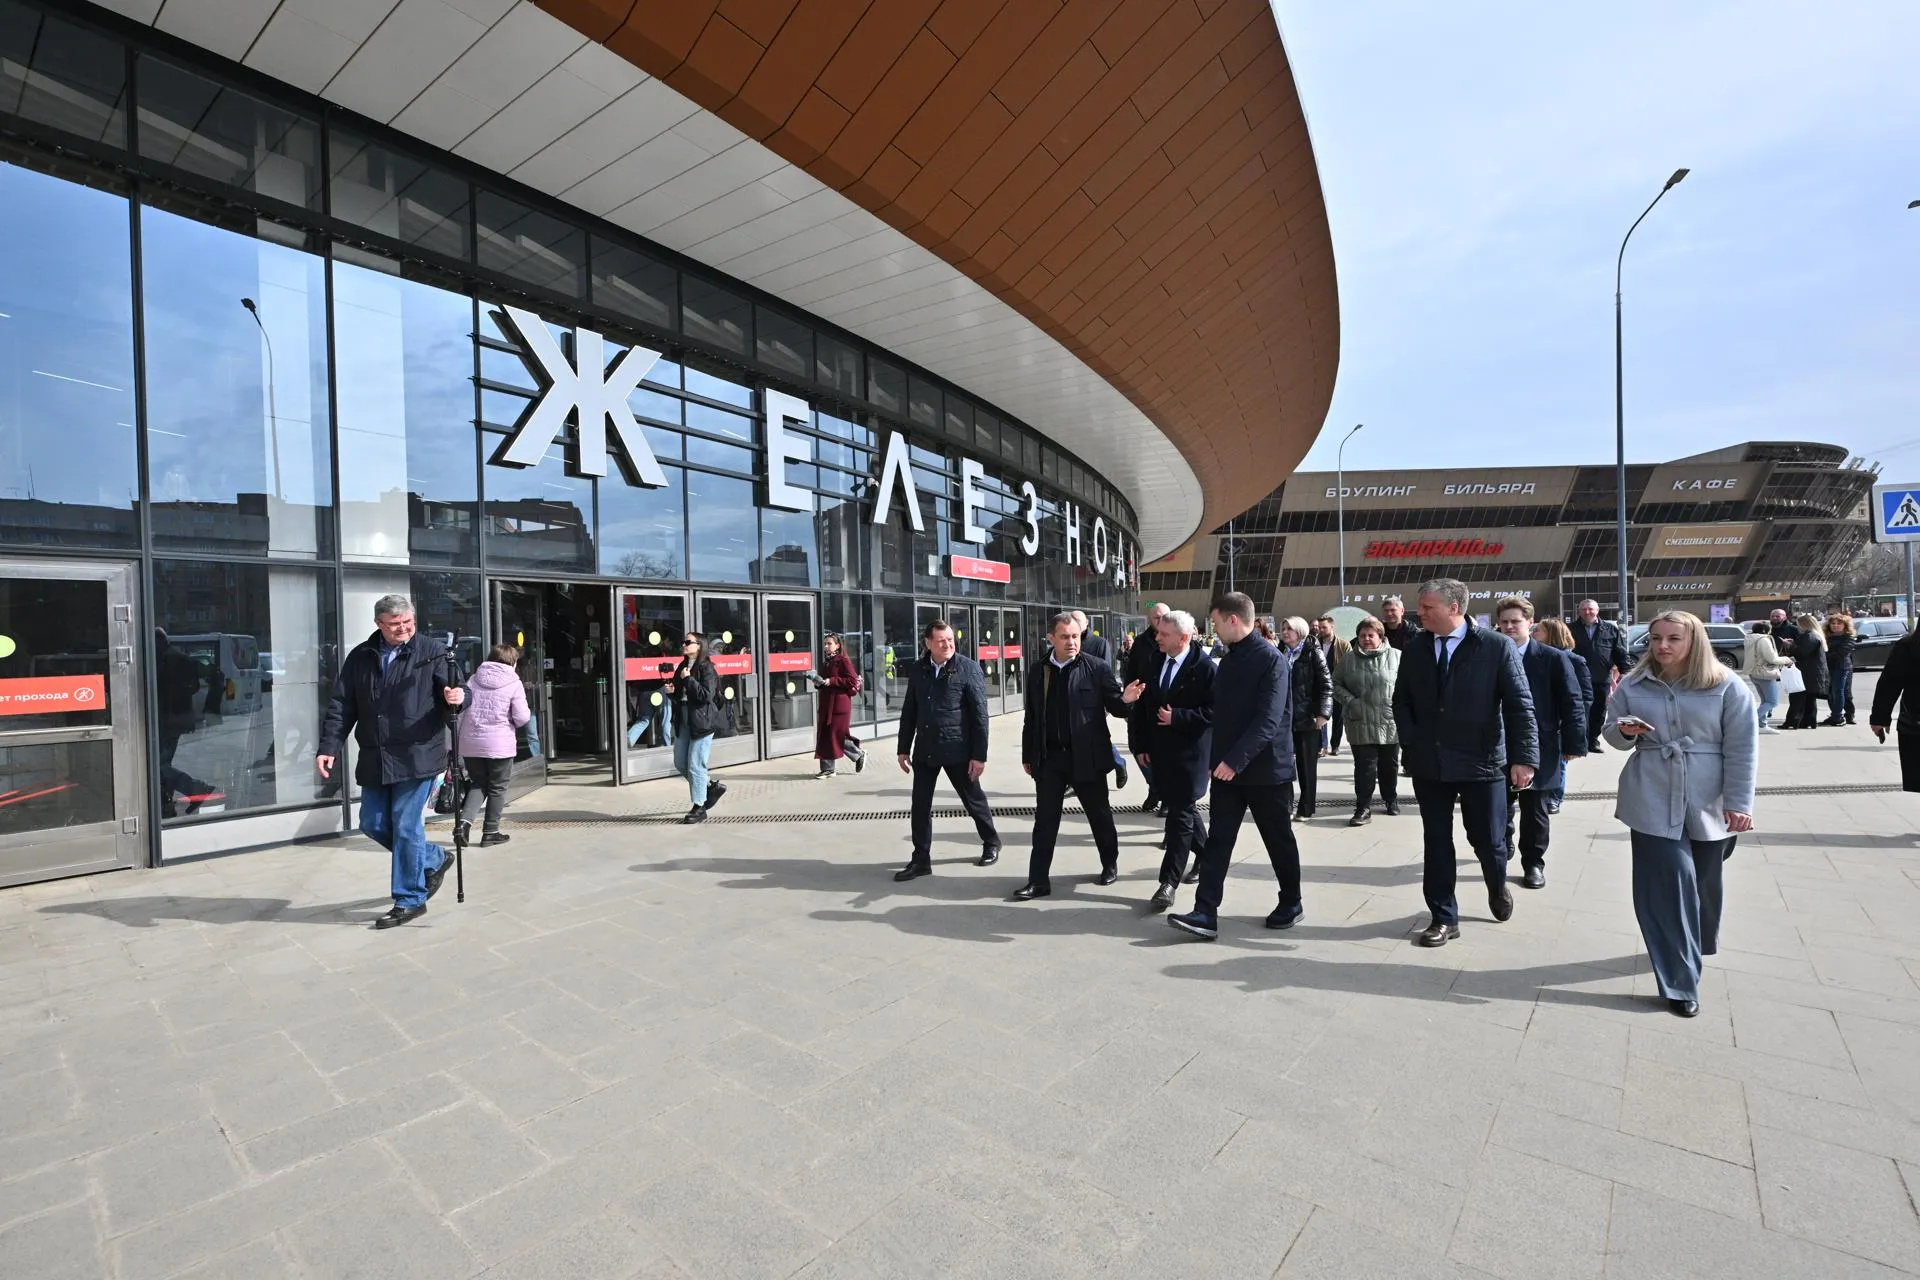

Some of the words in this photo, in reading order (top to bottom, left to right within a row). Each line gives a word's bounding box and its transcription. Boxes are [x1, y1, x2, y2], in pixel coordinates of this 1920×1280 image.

[502, 304, 1128, 589] ЖЕЛЕЗНОД
[1672, 478, 1738, 490] КАФЕ
[1325, 485, 1417, 498] БОУЛИНГ
[1443, 482, 1536, 495] БИЛЬЯРД
[1665, 537, 1713, 546] СМЕШНЫЕ
[1714, 536, 1743, 545] ЦЕНЫ
[1656, 582, 1713, 591] SUNLIGHT
[1469, 590, 1491, 599] ТОЙ
[1494, 589, 1531, 599] ПРАЙД
[14, 692, 69, 702] прохода
